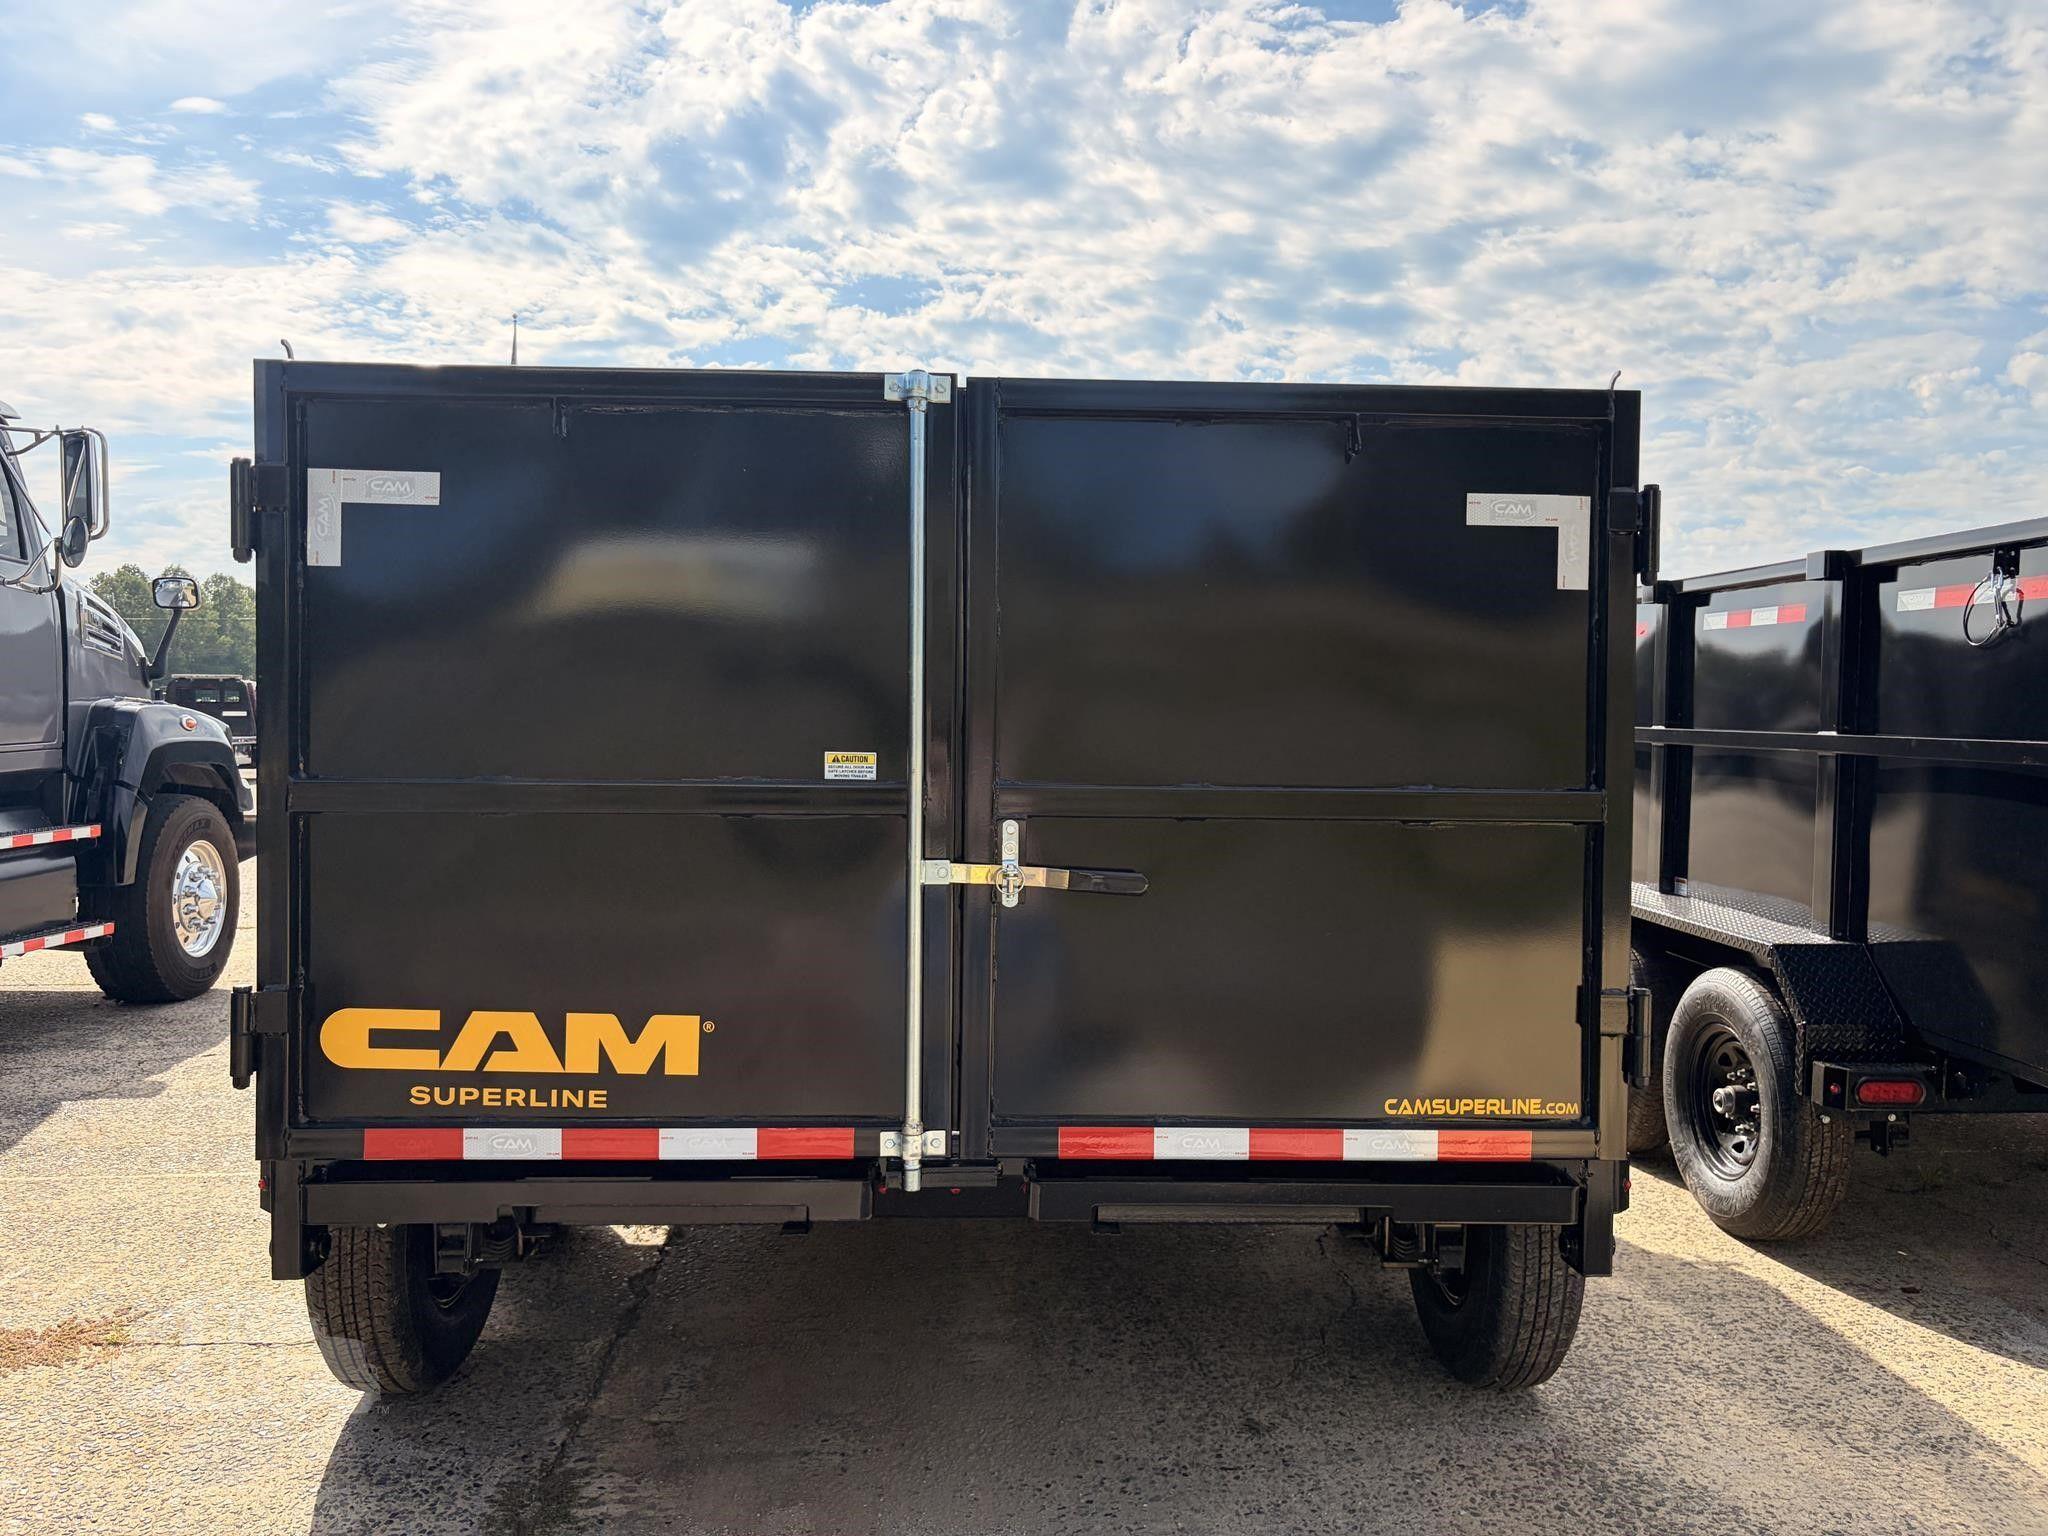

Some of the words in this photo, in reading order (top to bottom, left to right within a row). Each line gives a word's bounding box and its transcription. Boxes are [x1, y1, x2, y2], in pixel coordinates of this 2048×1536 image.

[841, 755, 868, 763] CAUTION
[320, 1008, 700, 1076] CAM
[409, 1086, 607, 1109] SUPERLINE
[1182, 1137, 1221, 1149] CAM
[1371, 1139, 1410, 1150] CAM
